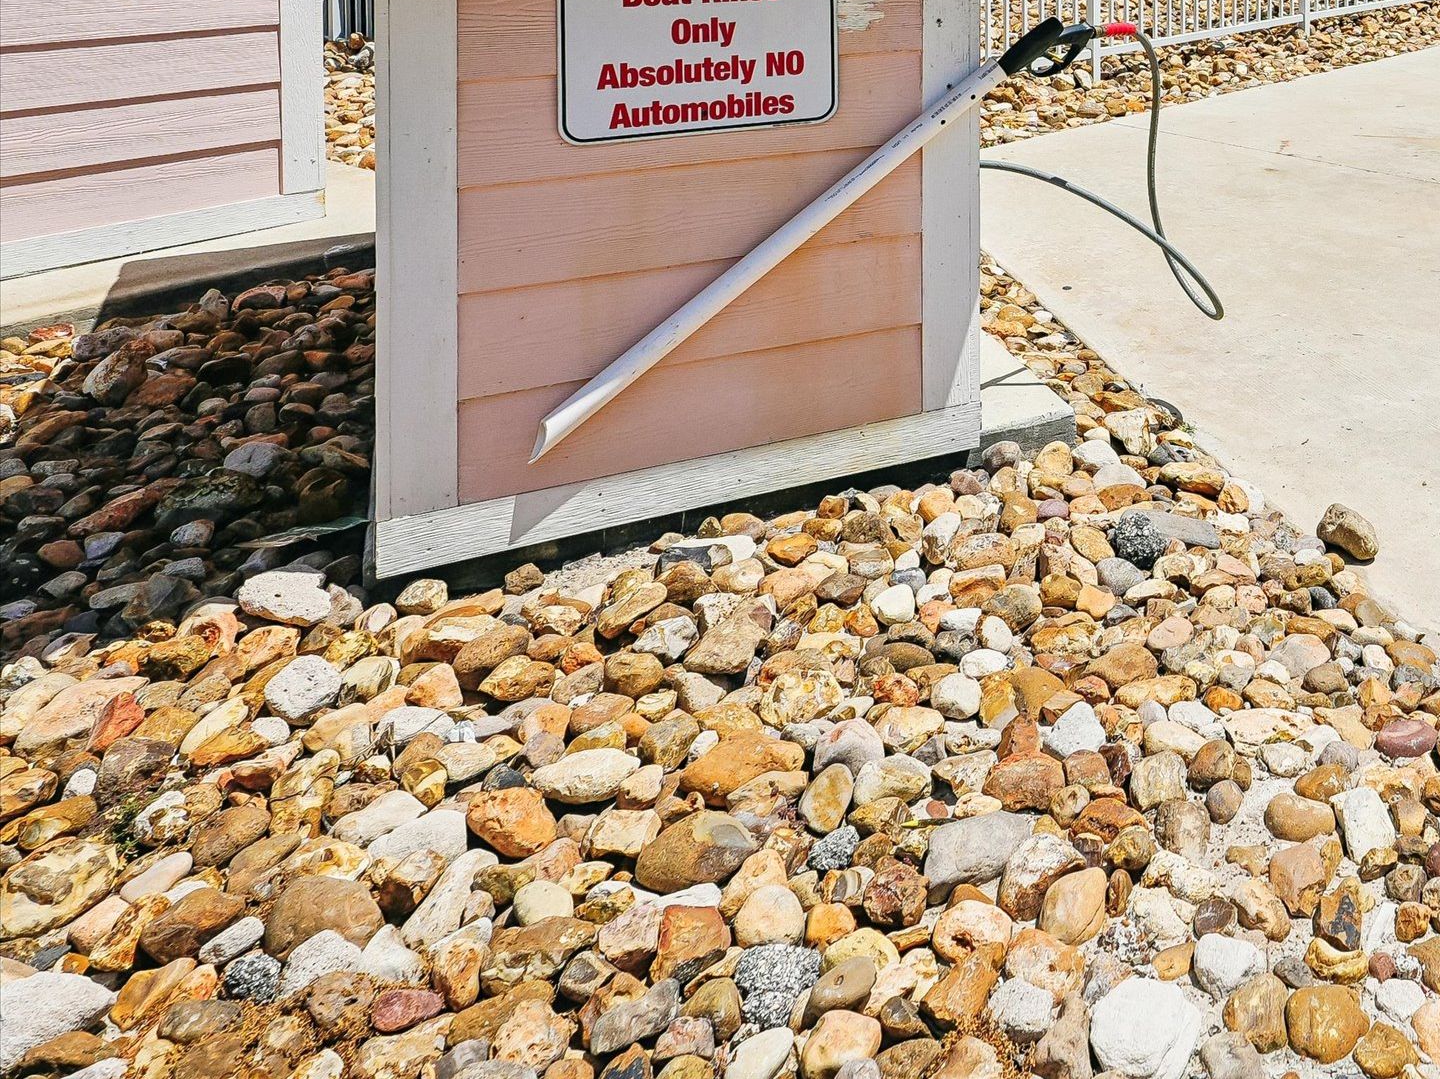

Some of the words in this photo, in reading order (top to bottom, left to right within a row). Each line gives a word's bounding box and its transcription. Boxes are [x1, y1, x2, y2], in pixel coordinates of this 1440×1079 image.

[671, 17, 736, 47] Only
[597, 55, 756, 90] Absolutely
[766, 50, 805, 77] NO
[609, 92, 795, 130] Automobiles
